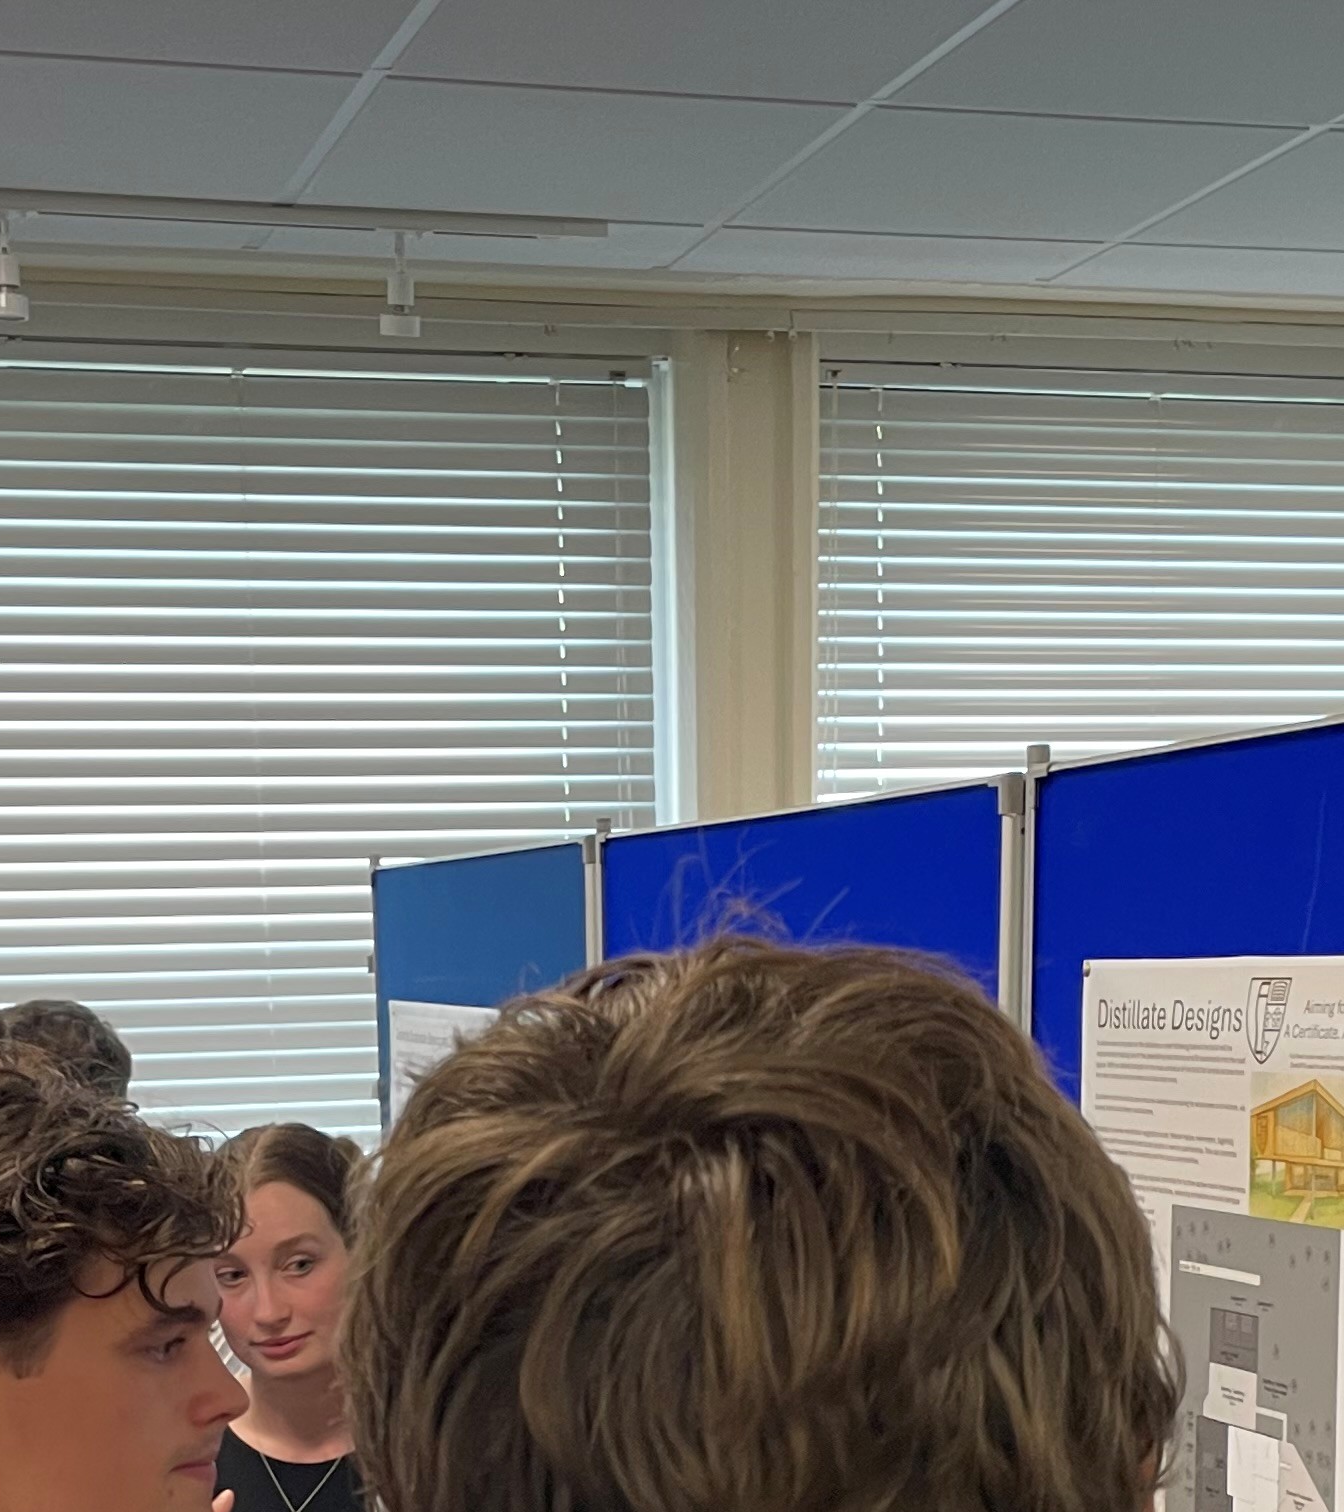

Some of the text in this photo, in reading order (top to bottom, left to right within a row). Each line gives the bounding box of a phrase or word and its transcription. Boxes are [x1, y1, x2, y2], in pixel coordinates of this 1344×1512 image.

[1305, 1000, 1335, 1018] Aiming
[1097, 998, 1243, 1040] Distillate Designs
[1283, 1023, 1291, 1039] A
